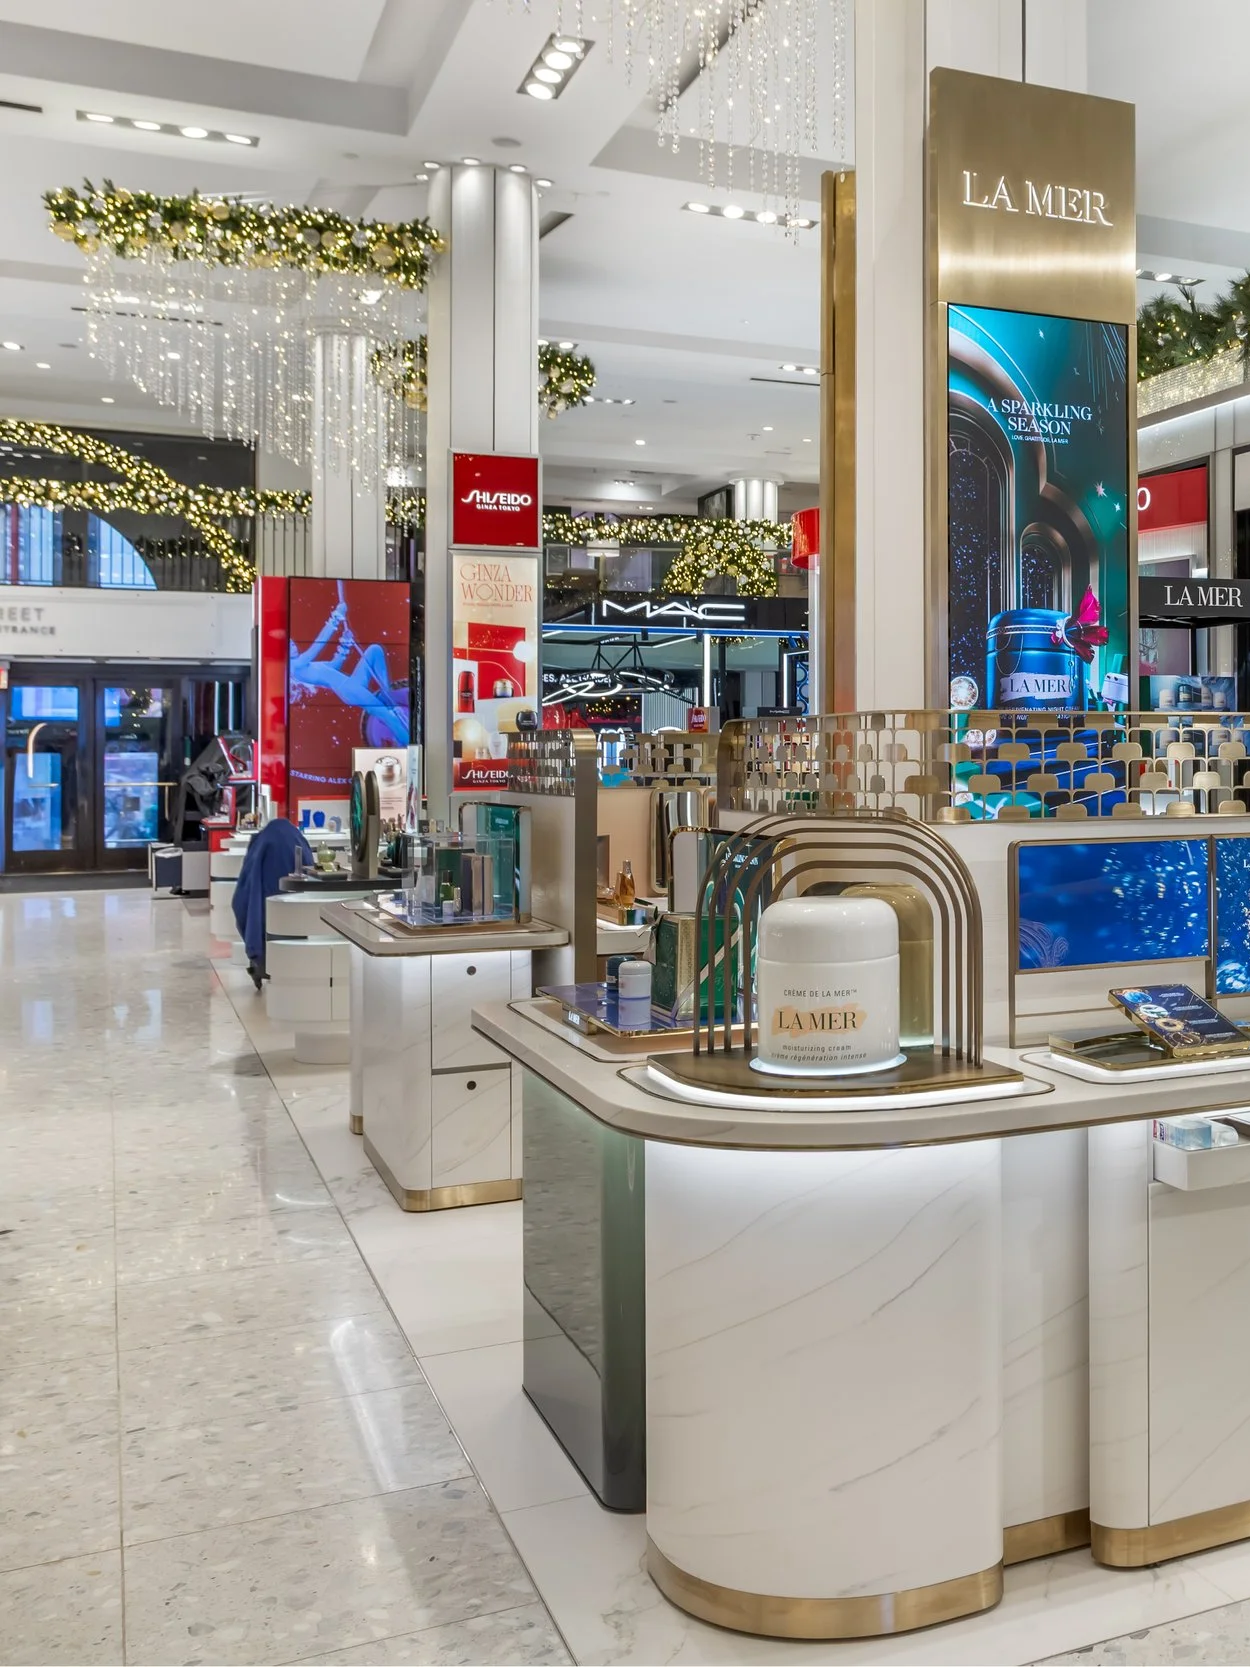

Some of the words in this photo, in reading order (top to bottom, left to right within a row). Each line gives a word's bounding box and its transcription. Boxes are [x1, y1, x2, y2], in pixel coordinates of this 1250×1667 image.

[962, 170, 1019, 212] LA
[1025, 180, 1114, 227] MER
[987, 397, 999, 413] A
[1001, 398, 1093, 421] SPARKLING
[1008, 416, 1071, 435] SEASON
[461, 489, 532, 506] SHISEIDO
[476, 503, 498, 511] GINZA
[499, 504, 521, 512] TOKYO
[460, 563, 512, 583] GINZA
[461, 583, 533, 602] WONDER
[1164, 585, 1194, 607] LA
[1197, 586, 1244, 608] MER
[0, 625, 56, 635] TRANCE
[1010, 679, 1030, 693] LA
[1034, 679, 1066, 693] MER
[783, 989, 807, 997] CRÈME
[778, 1010, 803, 1030] LA
[809, 1011, 857, 1030] MER
[782, 1044, 826, 1053] moisturizing
[840, 1052, 867, 1060] intense
